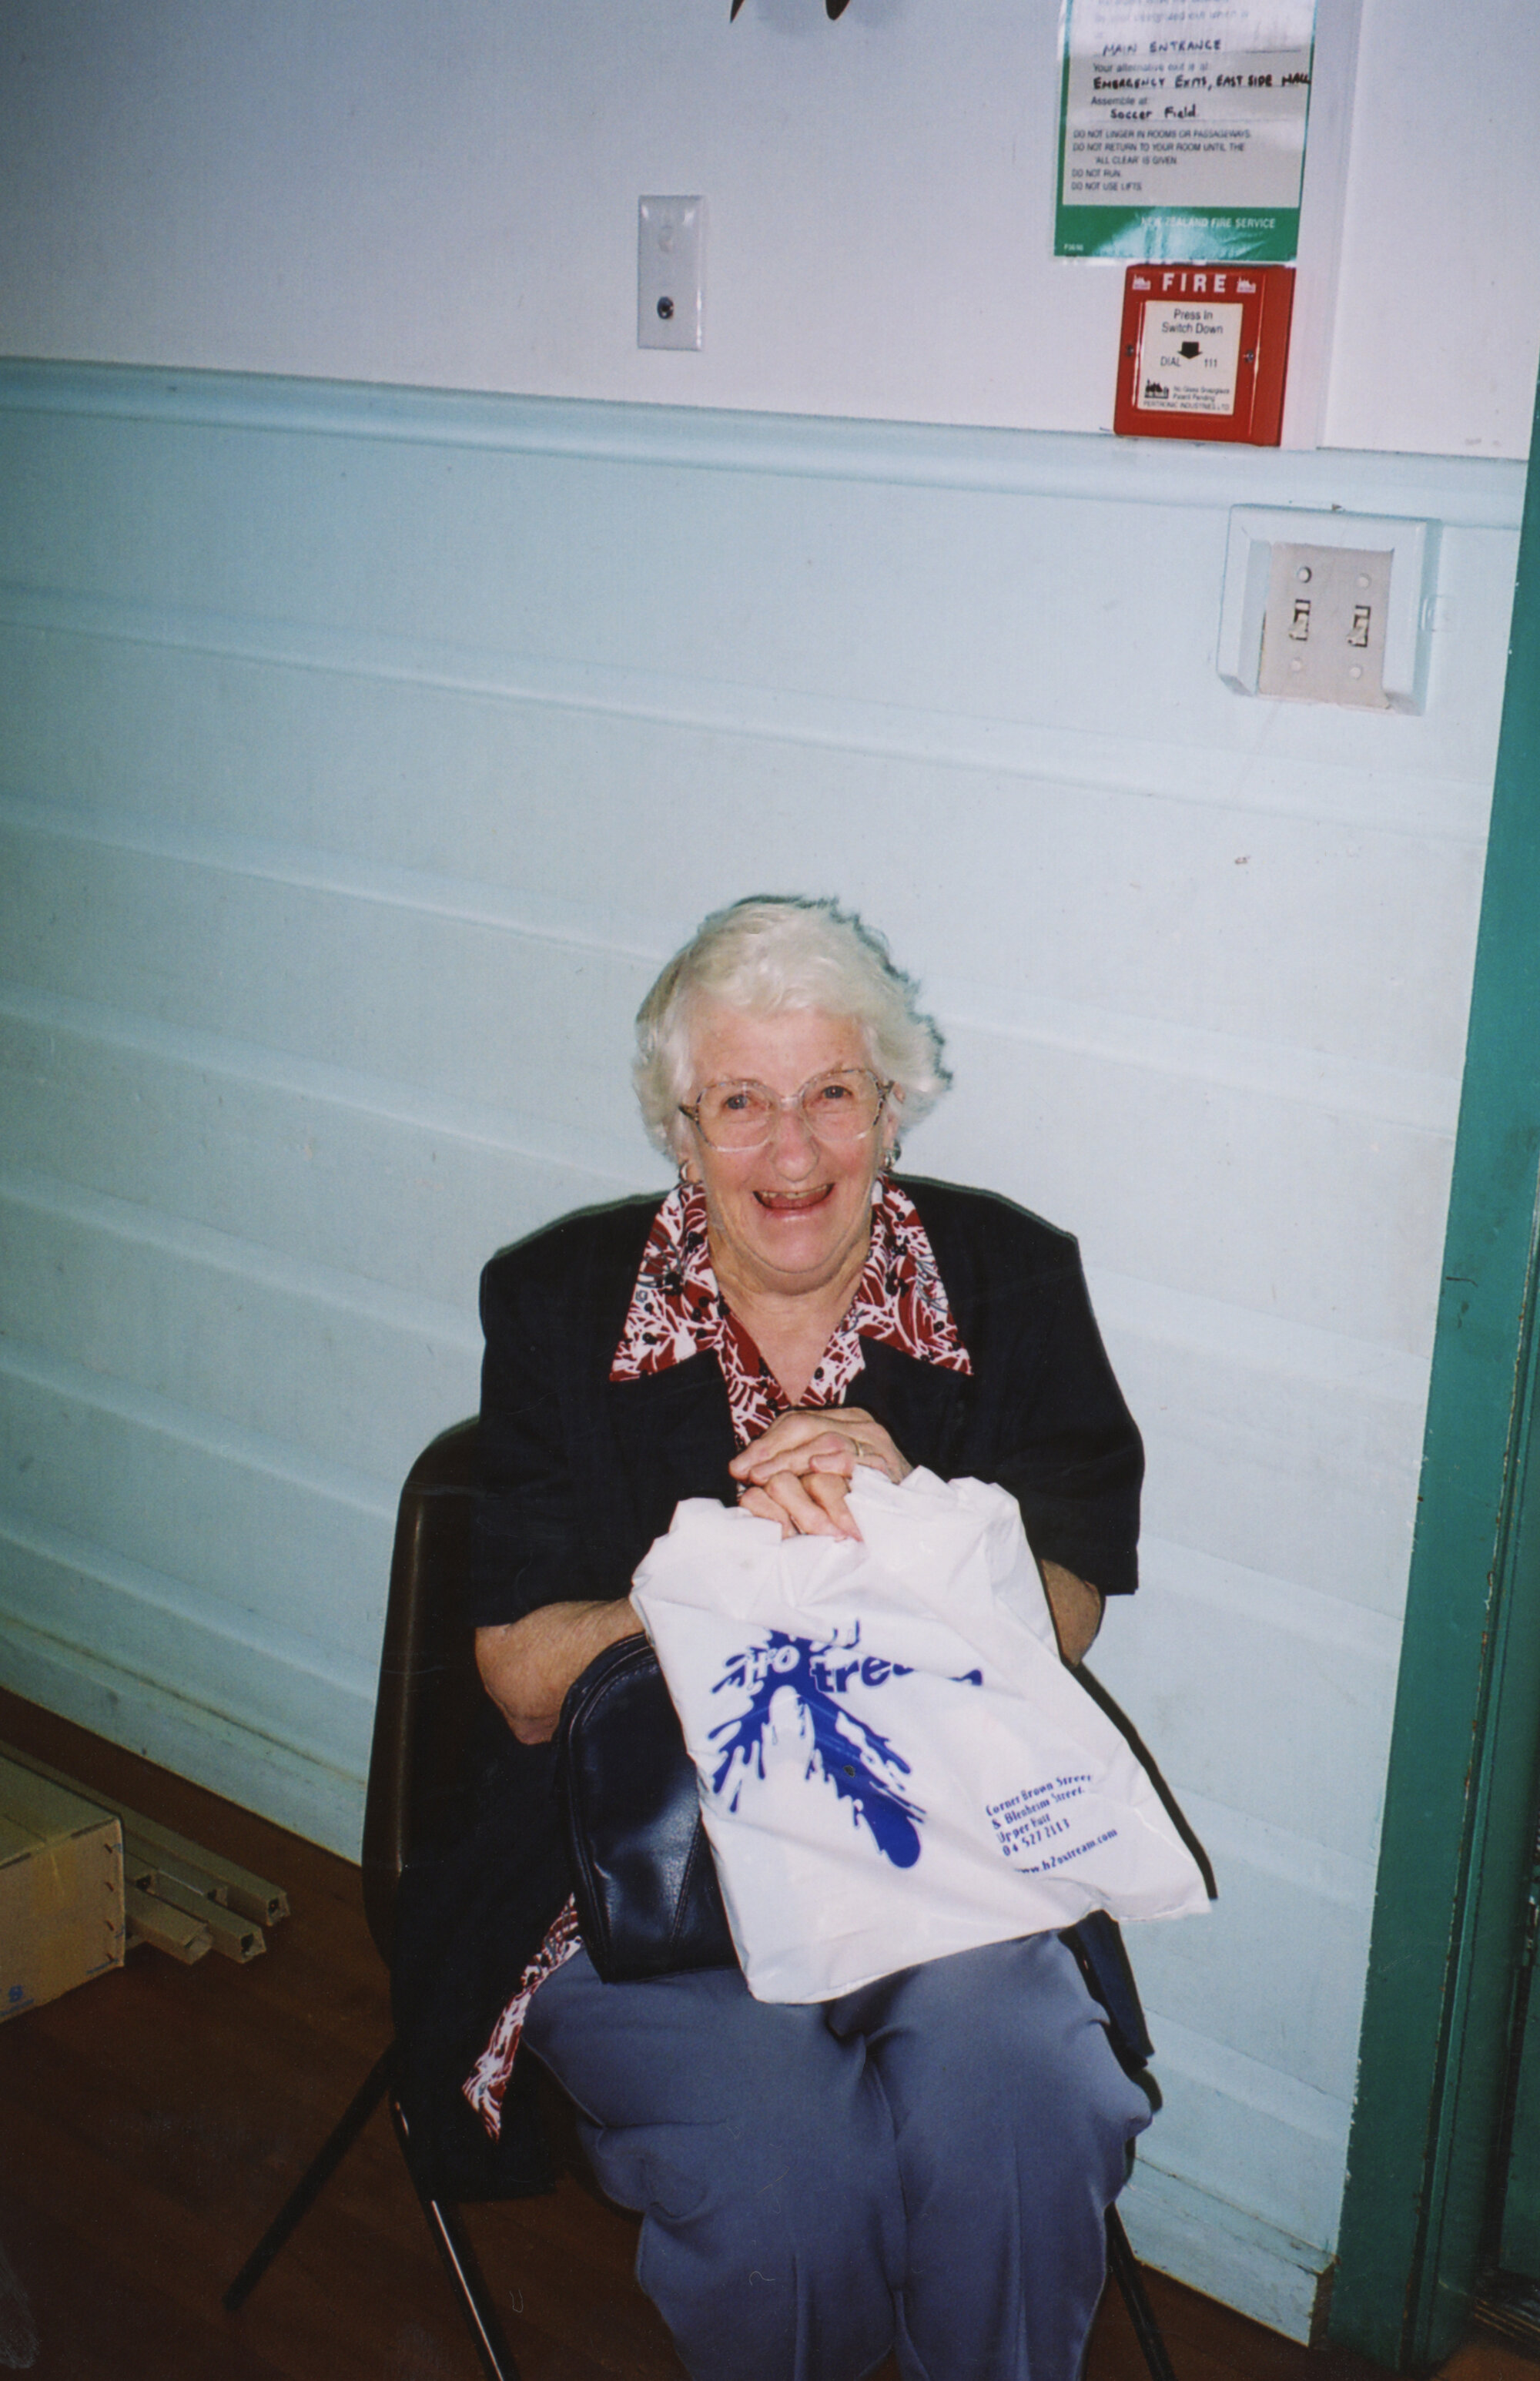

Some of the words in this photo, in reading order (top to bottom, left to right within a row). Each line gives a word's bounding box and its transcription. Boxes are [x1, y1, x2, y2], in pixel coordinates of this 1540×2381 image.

[1102, 43, 1137, 56] MAIN
[1149, 39, 1221, 53] ENTRANCE
[1093, 63, 1113, 72] Your
[1093, 76, 1165, 89] EMERGENCY
[1217, 75, 1243, 87] EAST
[1248, 74, 1272, 87] SIDE
[1091, 96, 1135, 105] Assemble
[1110, 109, 1153, 119] Soccer
[1164, 104, 1197, 119] Field
[1073, 130, 1086, 139] DO
[1087, 129, 1103, 138] NOT
[1106, 129, 1135, 139] LINGER
[1147, 129, 1177, 139] ROOMS
[1073, 143, 1085, 152] DO
[1204, 143, 1226, 152] UNTIL
[1230, 142, 1245, 151] THE
[1153, 156, 1177, 165] GIVEN
[1072, 169, 1084, 177] DO
[1086, 169, 1101, 177] NOT
[1071, 182, 1083, 190] DO
[1086, 182, 1100, 190] NOT
[1103, 182, 1118, 190] USE
[1210, 217, 1232, 228] FIRE
[1235, 217, 1276, 229] SERVICE
[1163, 273, 1227, 293] FIRE
[1173, 308, 1201, 320] Press
[1204, 310, 1214, 320] In
[1161, 321, 1194, 333] Switch
[1195, 322, 1224, 334] Down
[1160, 356, 1182, 367] DIAL
[986, 1796, 1020, 1817] Corner
[1021, 1783, 1053, 1800] Brown
